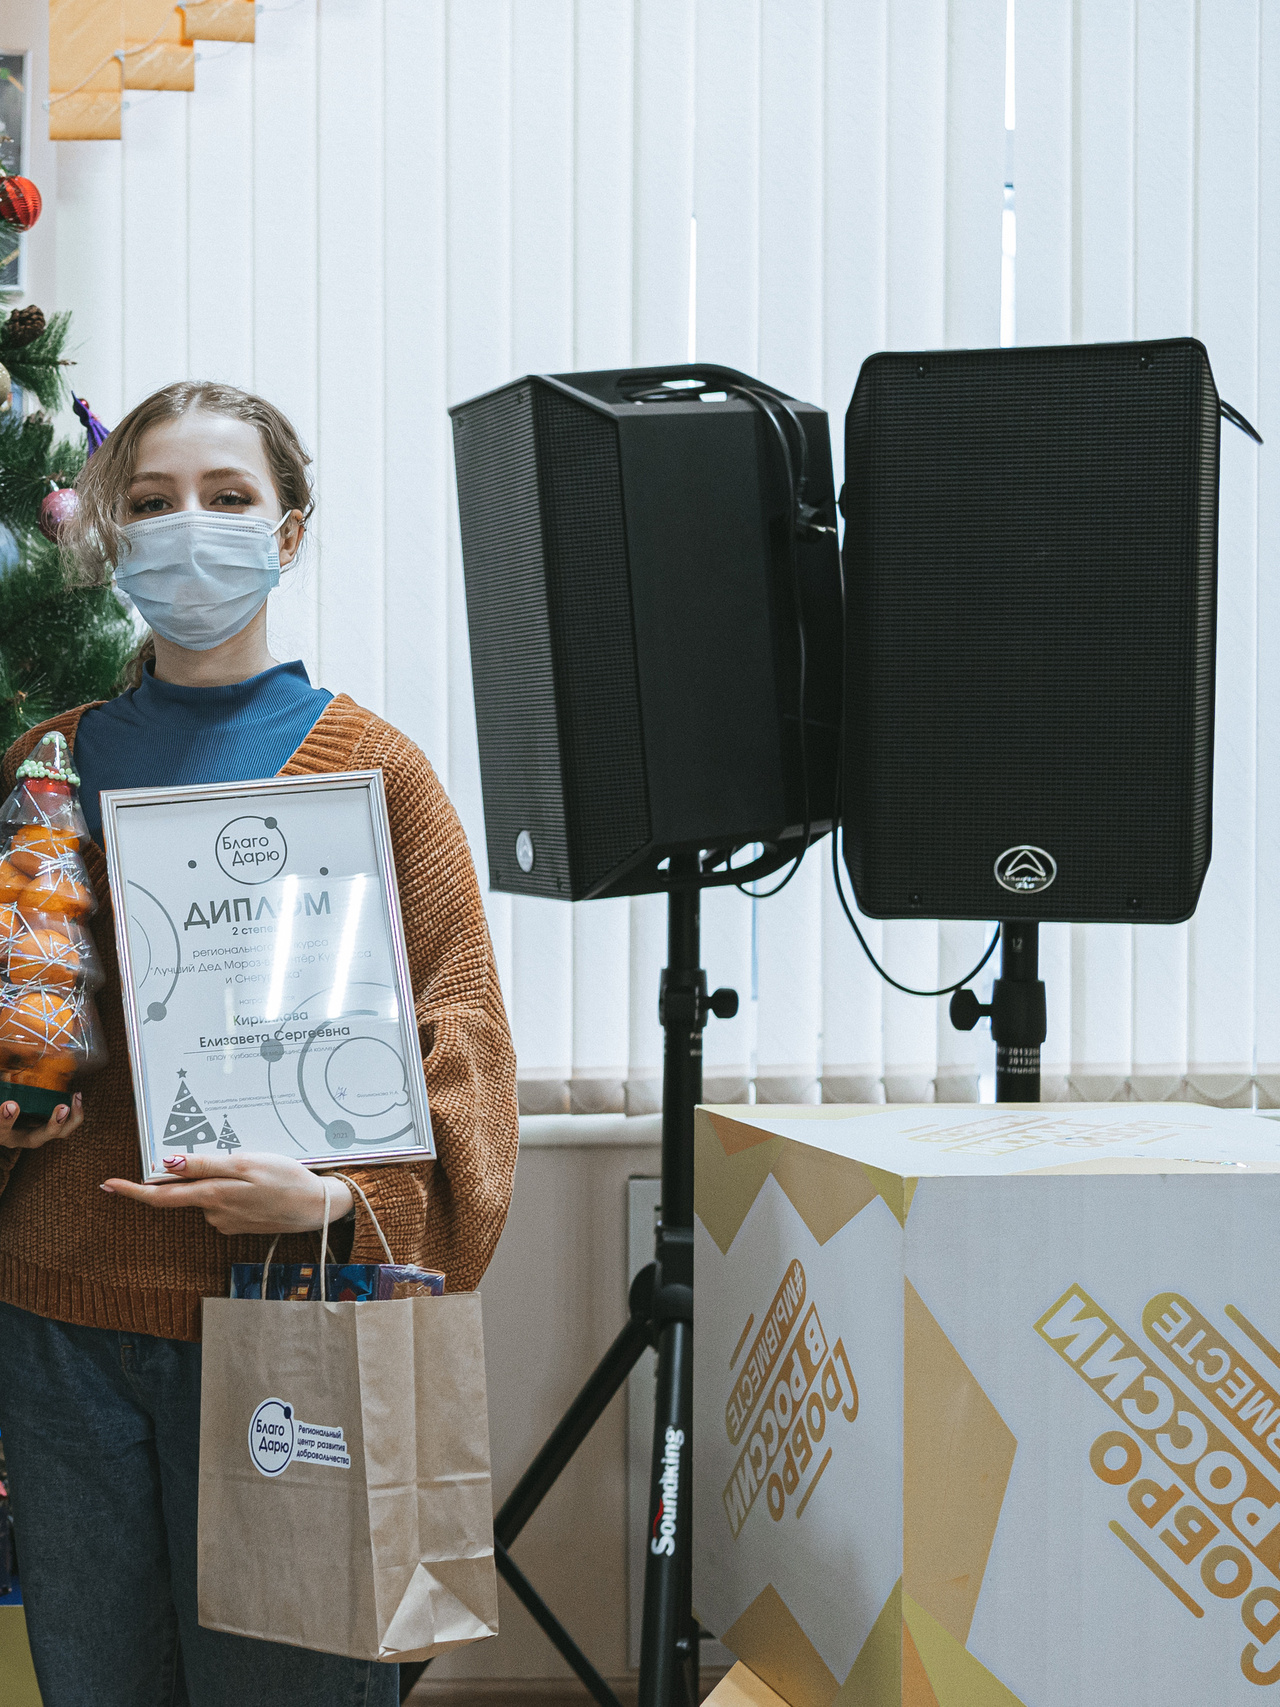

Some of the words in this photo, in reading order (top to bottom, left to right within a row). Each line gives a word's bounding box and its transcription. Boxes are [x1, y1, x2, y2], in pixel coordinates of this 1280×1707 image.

[222, 836, 269, 850] Благо
[232, 850, 280, 867] Дарю
[232, 926, 239, 936] 2
[192, 943, 274, 959] регионального
[198, 962, 222, 974] Дед
[225, 976, 232, 984] и
[233, 1011, 309, 1027] Кирова
[199, 1033, 270, 1048] Елизавета
[274, 1026, 351, 1042] Сергеевна
[333, 1131, 348, 1140] 2021
[804, 1311, 826, 1367] В
[727, 1261, 805, 1436] #МЫВМЕСТЕ
[256, 1419, 285, 1436] Благо
[1042, 1294, 1280, 1548] РОССИИ
[298, 1424, 342, 1439] Региональный
[724, 1348, 808, 1529] РОССИИ
[259, 1436, 290, 1454] Дарю
[297, 1438, 315, 1448] центр
[317, 1441, 346, 1452] развития
[297, 1449, 350, 1465] добровольчества
[651, 1425, 685, 1556] Soundking
